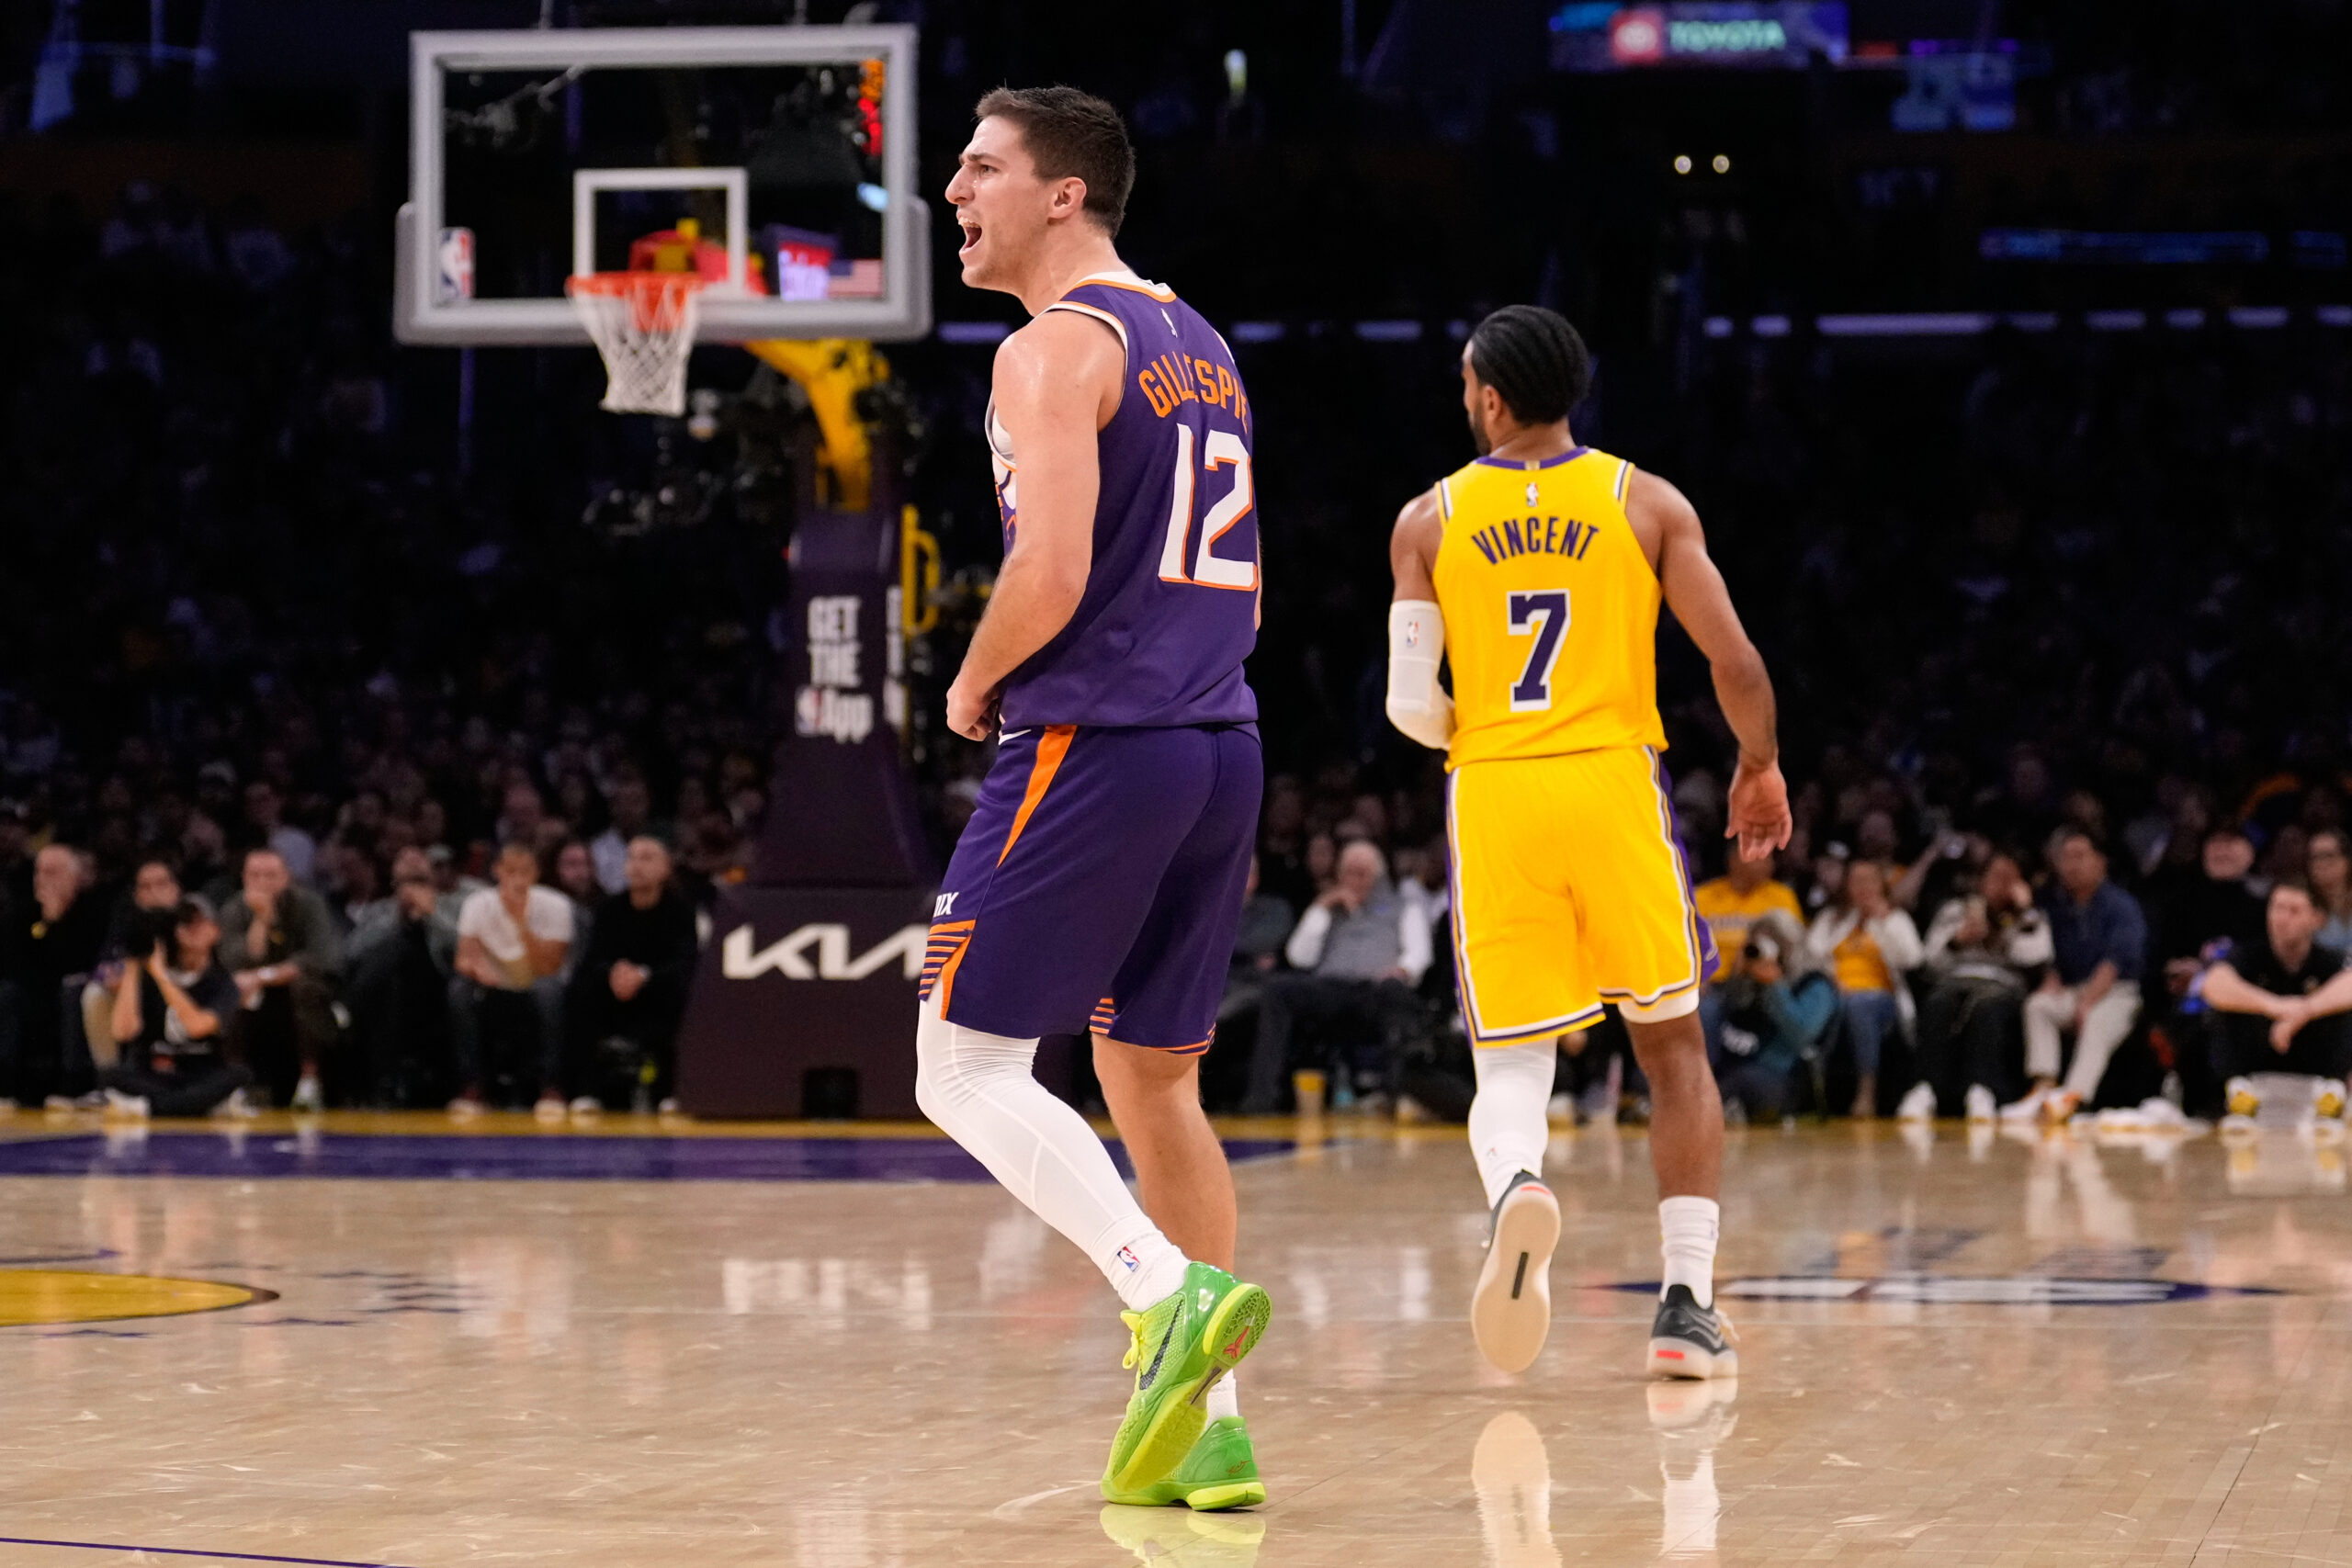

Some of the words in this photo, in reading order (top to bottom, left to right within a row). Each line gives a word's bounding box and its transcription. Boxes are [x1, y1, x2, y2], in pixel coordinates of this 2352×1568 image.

[1159, 423, 1258, 591] 12
[1471, 516, 1599, 565] VINCENT
[808, 595, 861, 639] GET
[808, 640, 862, 687] THE
[1507, 589, 1572, 713] 7
